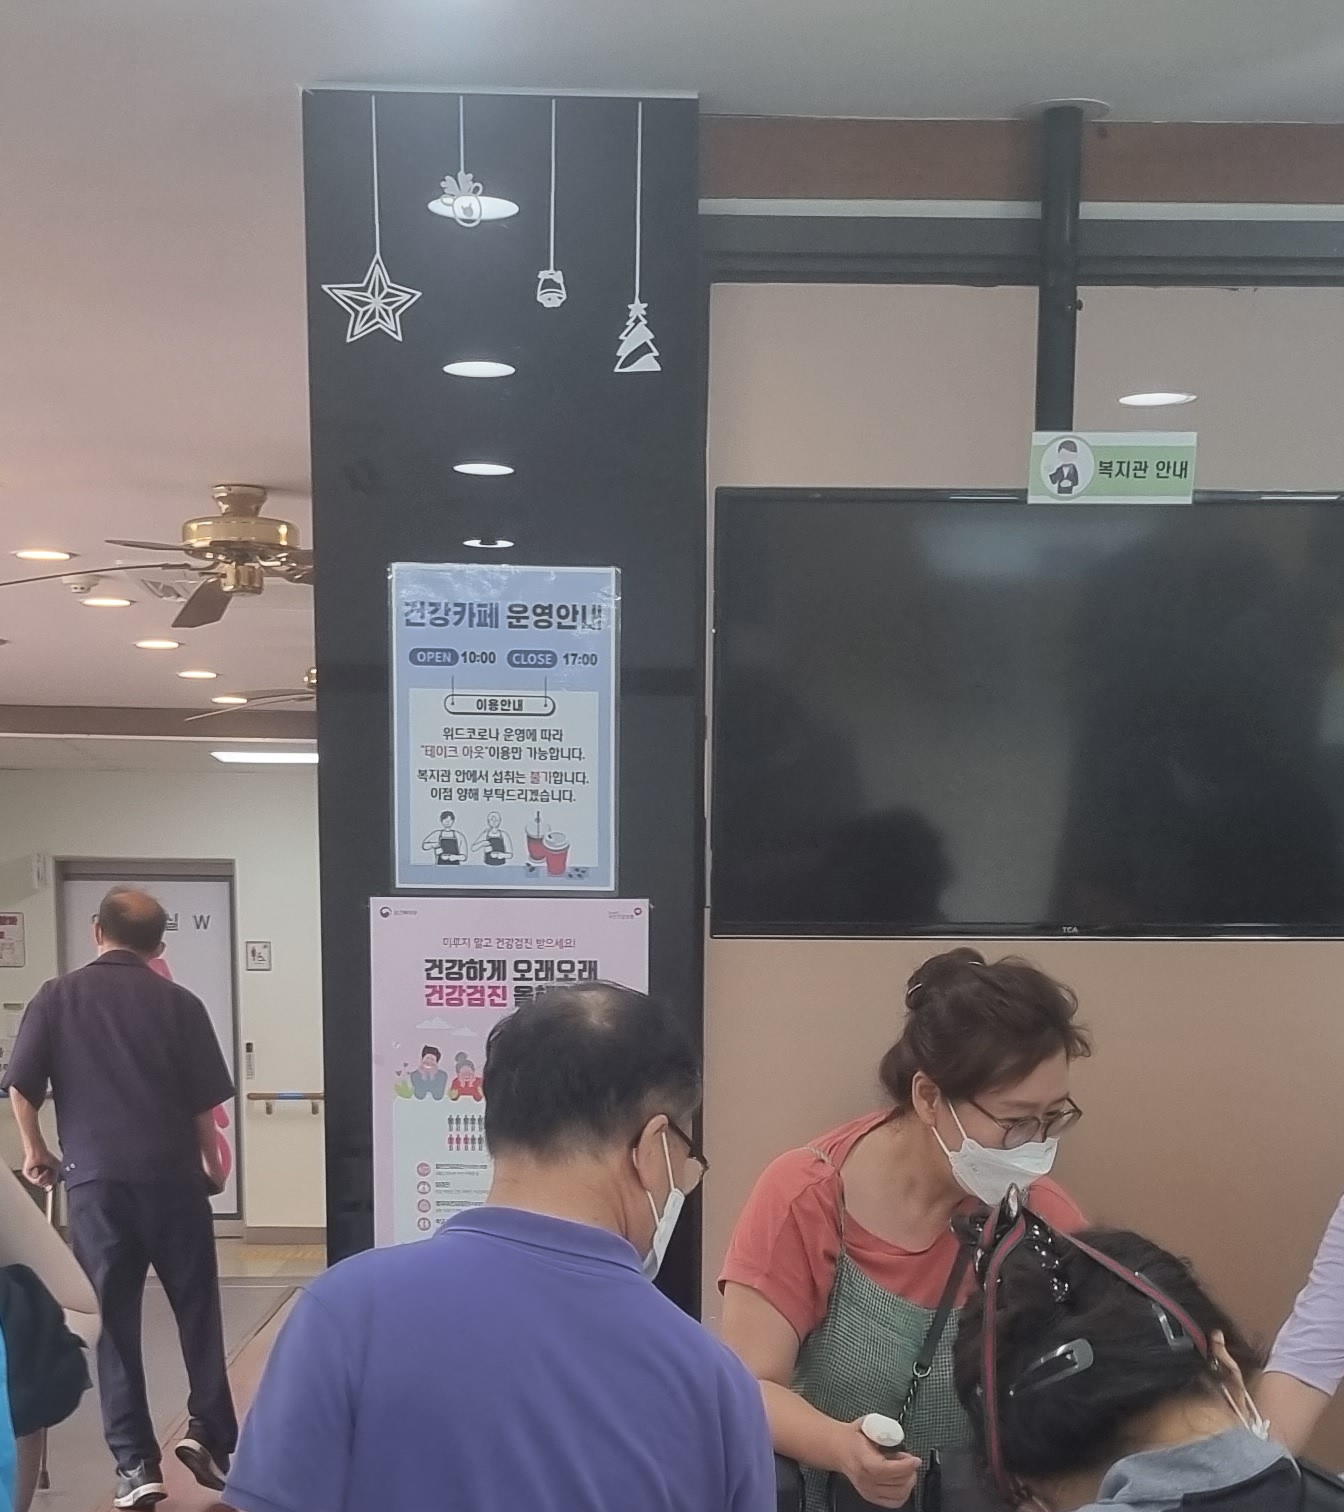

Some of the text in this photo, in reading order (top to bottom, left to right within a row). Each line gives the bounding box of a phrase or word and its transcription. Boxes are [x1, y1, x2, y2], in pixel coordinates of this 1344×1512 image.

[1098, 460, 1188, 479] 복지관 안내
[404, 601, 602, 630] 건강카페 운영안내
[416, 651, 598, 666] OPEN 10:00 CLOSE 17:00
[476, 698, 524, 712] 이용안내
[443, 727, 564, 743] 위드코로나 운영에 따라
[528, 747, 586, 761] 가능합니다.
[417, 769, 590, 785] 복지관 안에서 섭취는 불가합니다.
[430, 787, 577, 803] 이점 양해 부탁드리겠습니다.
[193, 914, 211, 930] W
[496, 937, 533, 950] 건강검진
[535, 938, 576, 950] 받으세요!
[424, 959, 598, 982] 건강하게 오래오래
[424, 984, 508, 1008] 건강검진
